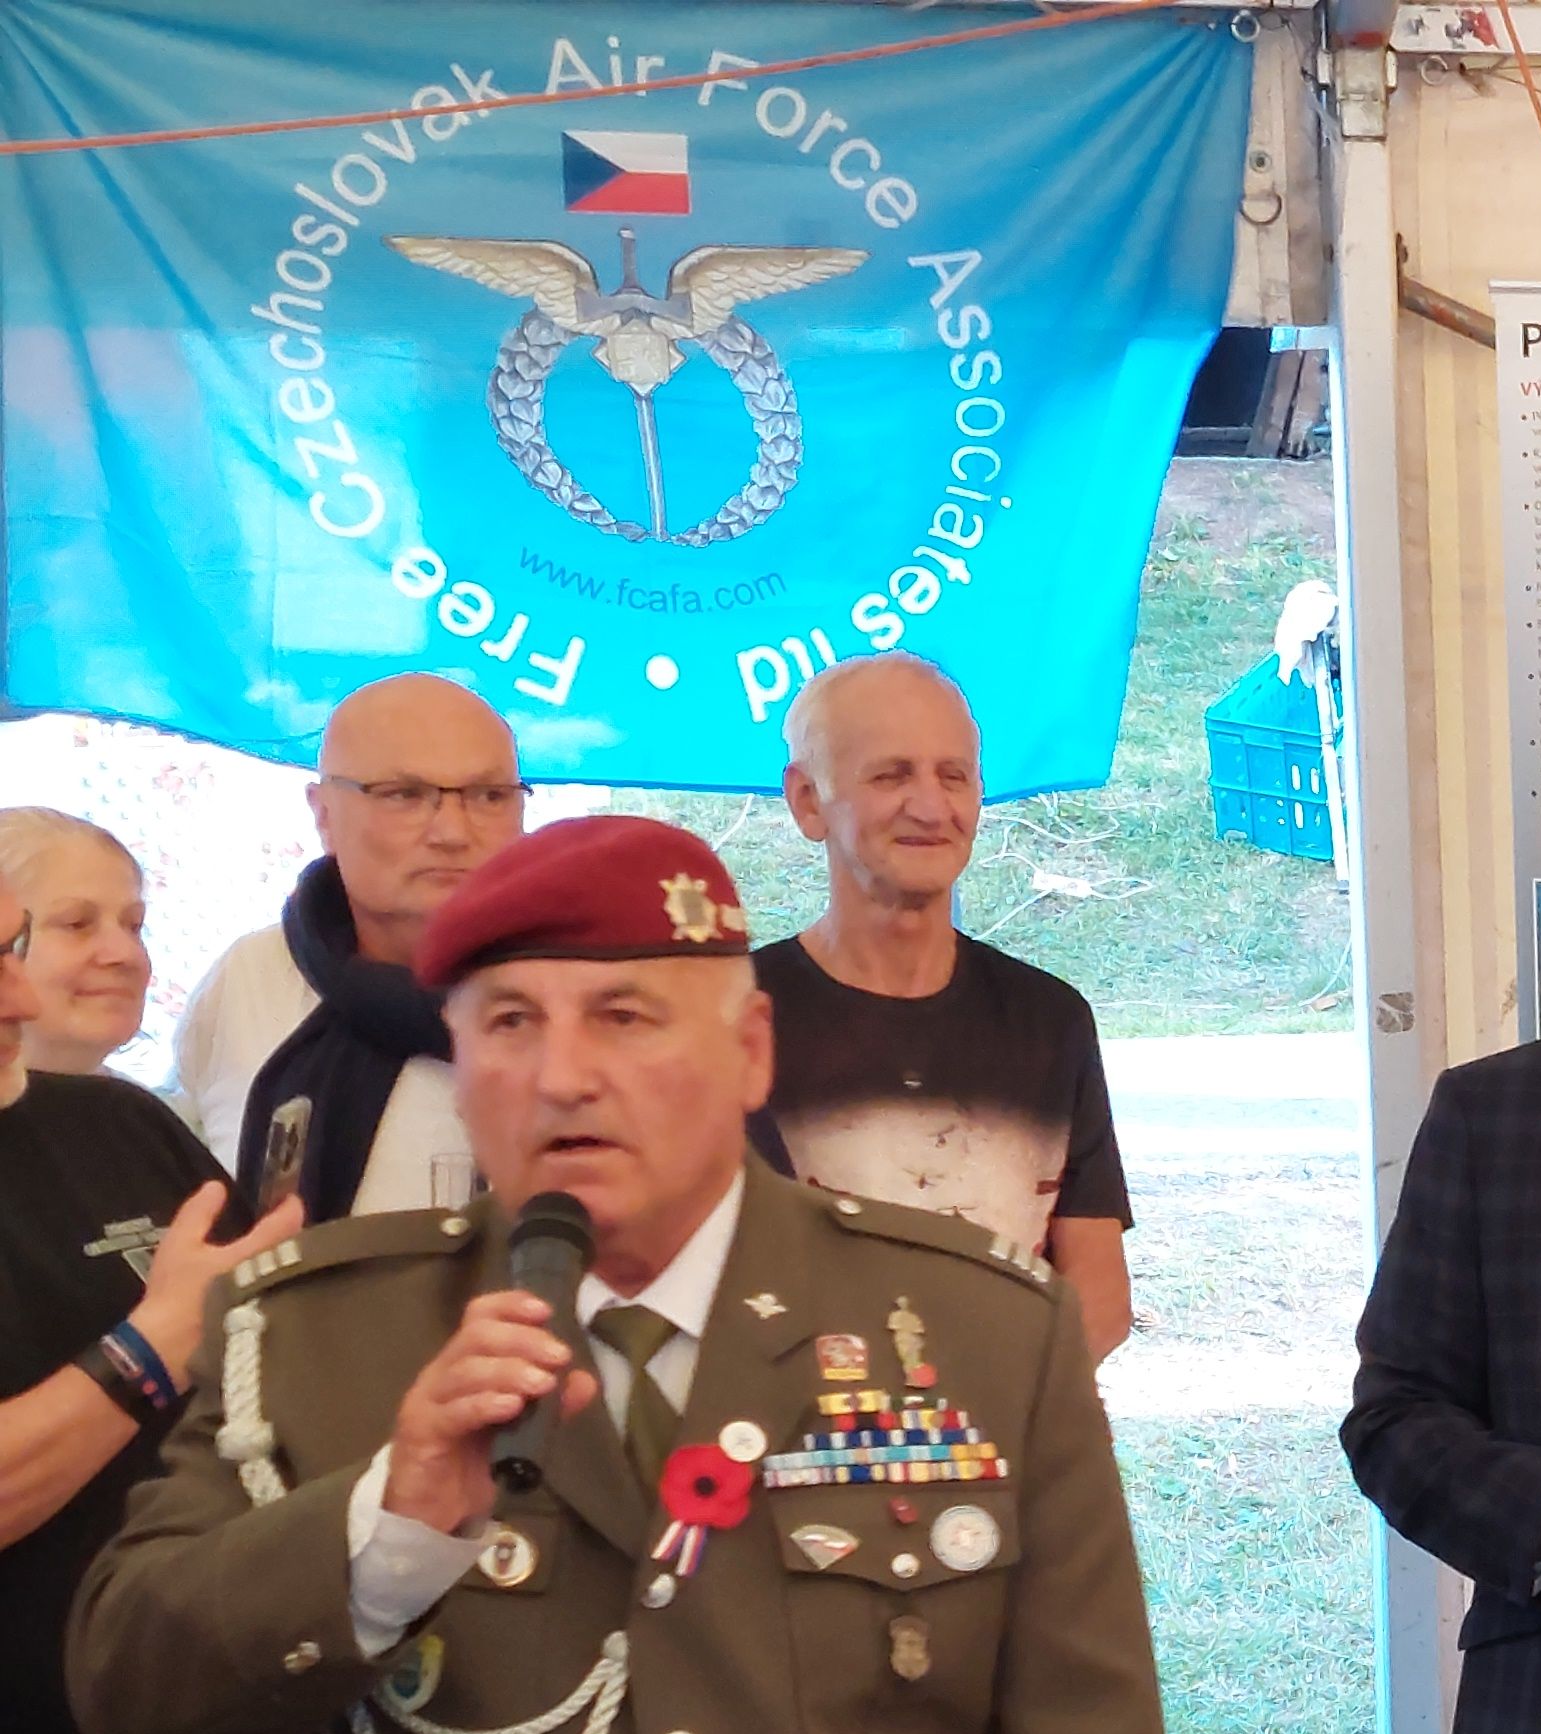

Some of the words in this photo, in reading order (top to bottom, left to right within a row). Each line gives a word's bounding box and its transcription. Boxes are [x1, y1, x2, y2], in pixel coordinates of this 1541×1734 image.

[545, 36, 664, 96] Air
[698, 50, 918, 230] Force
[251, 62, 510, 538] Czechoslovak
[850, 247, 1013, 652] Associates
[391, 545, 587, 706] Free
[518, 544, 789, 614] www.fcafa.com
